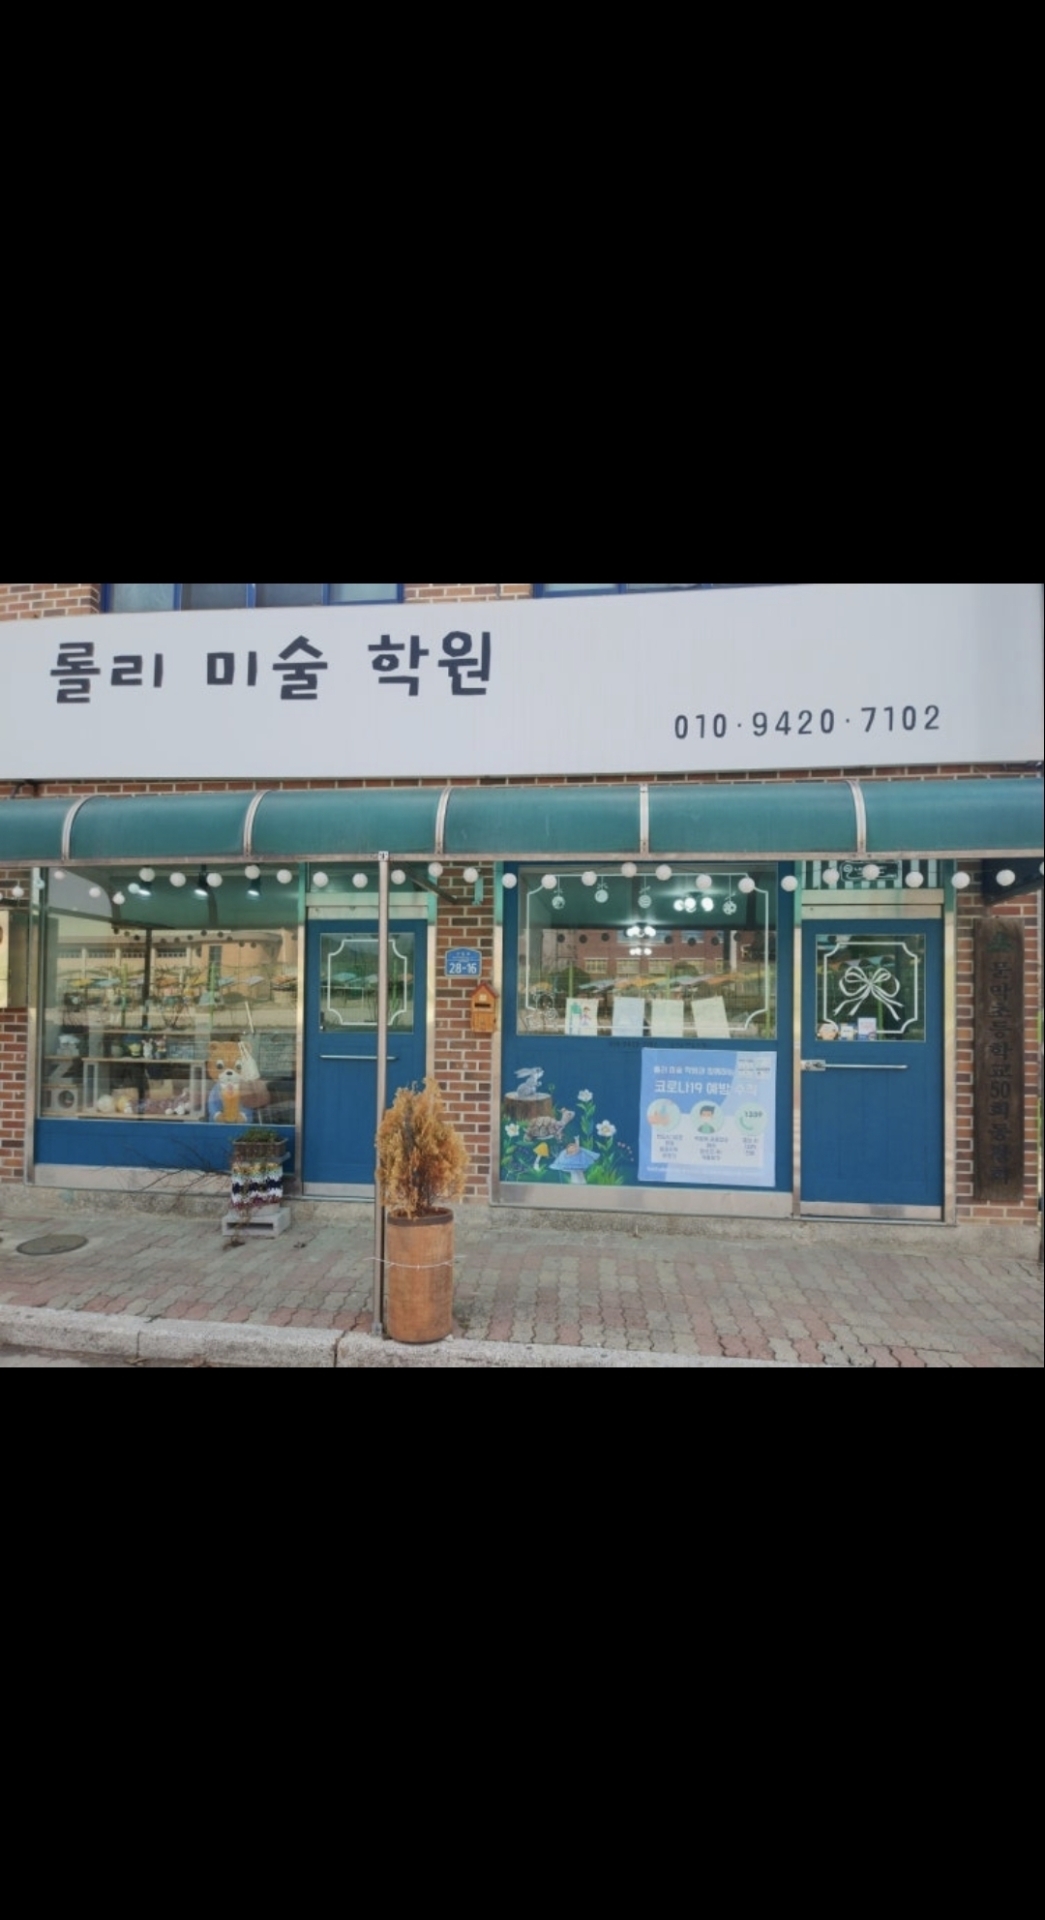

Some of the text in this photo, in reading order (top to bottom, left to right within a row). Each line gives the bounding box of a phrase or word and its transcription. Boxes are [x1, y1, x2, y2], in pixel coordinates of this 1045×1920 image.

[50, 630, 492, 704] 롤리 미술 학원
[449, 963, 478, 974] 28-16
[654, 1080, 703, 1095] 코로나19
